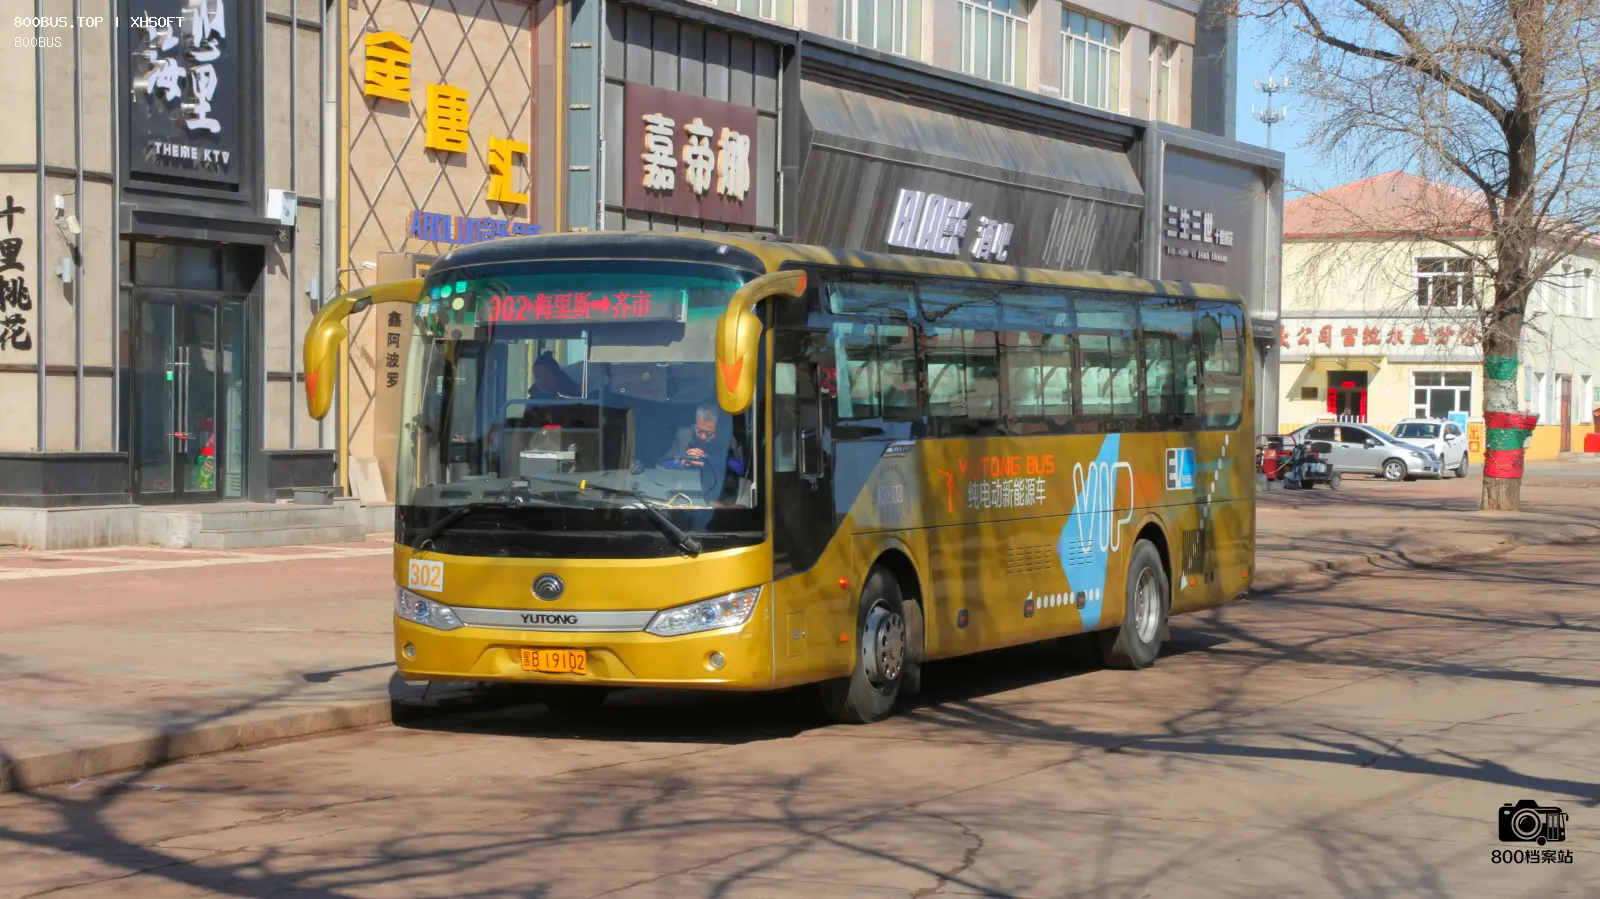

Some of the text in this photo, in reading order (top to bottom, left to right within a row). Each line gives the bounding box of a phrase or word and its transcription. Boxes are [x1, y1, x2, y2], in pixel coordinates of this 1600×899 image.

[154, 141, 230, 165] THEME KTV
[488, 295, 527, 321] 302
[386, 310, 402, 388] 鑫阿波罗
[958, 454, 1055, 479] YUTONG BUS
[968, 476, 1047, 510] 纯电动新能源车
[1072, 461, 1134, 554] VIP
[411, 562, 441, 589] 302
[520, 613, 579, 625] YUTONG
